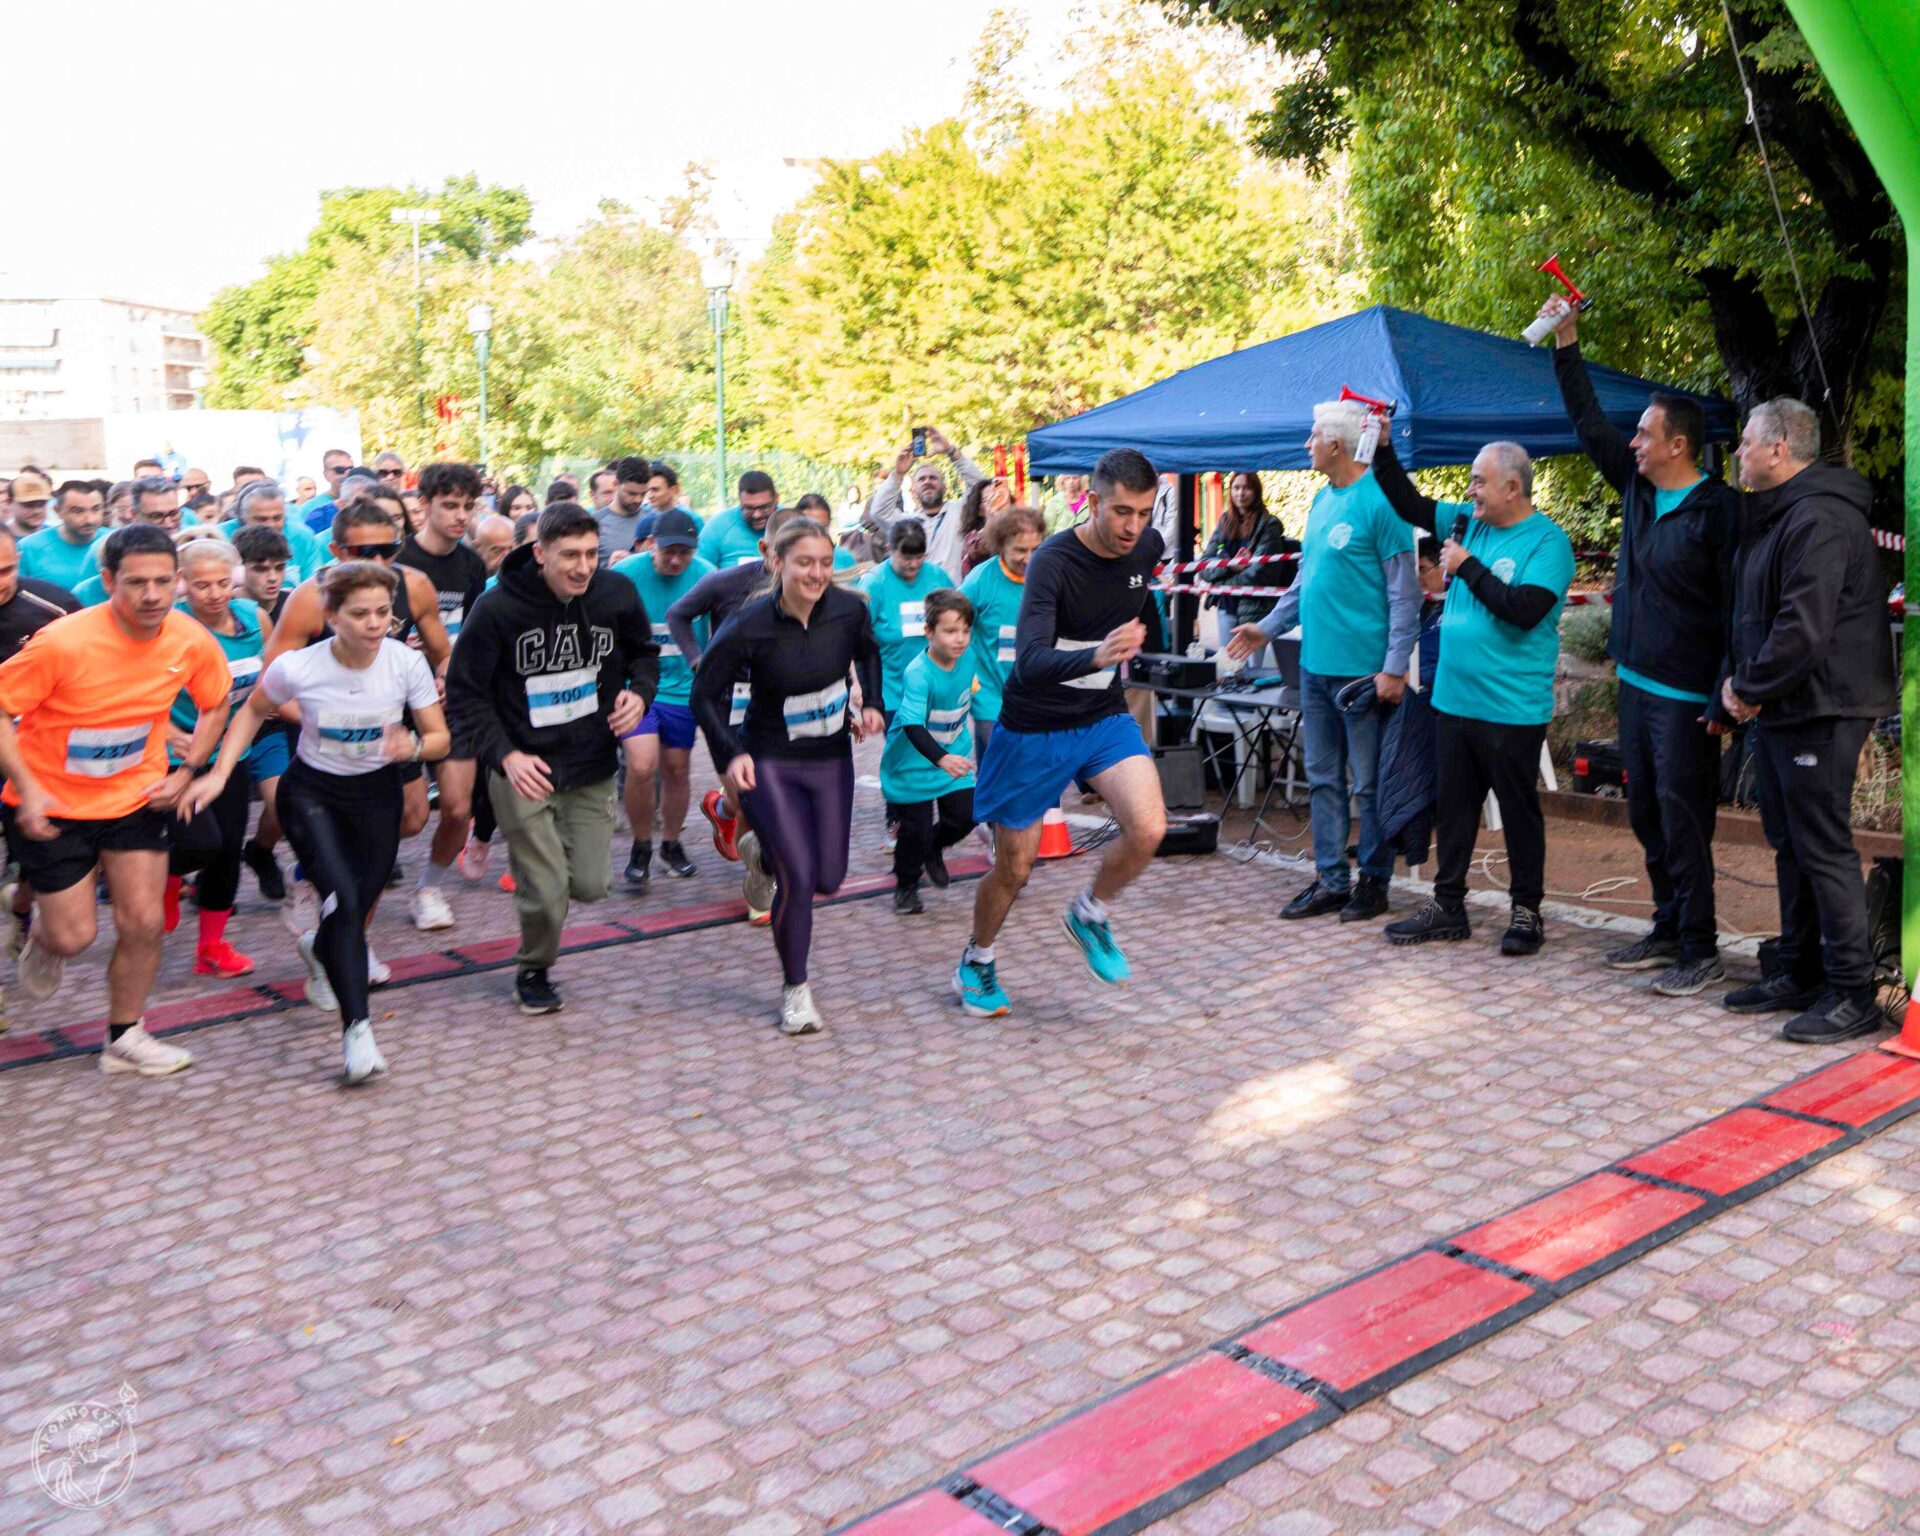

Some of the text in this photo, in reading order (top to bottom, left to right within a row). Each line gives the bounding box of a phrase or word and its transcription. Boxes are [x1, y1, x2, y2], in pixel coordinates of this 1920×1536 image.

[516, 624, 614, 675] GAP
[550, 687, 581, 705] 300
[342, 728, 383, 742] 275
[92, 742, 132, 760] 237
